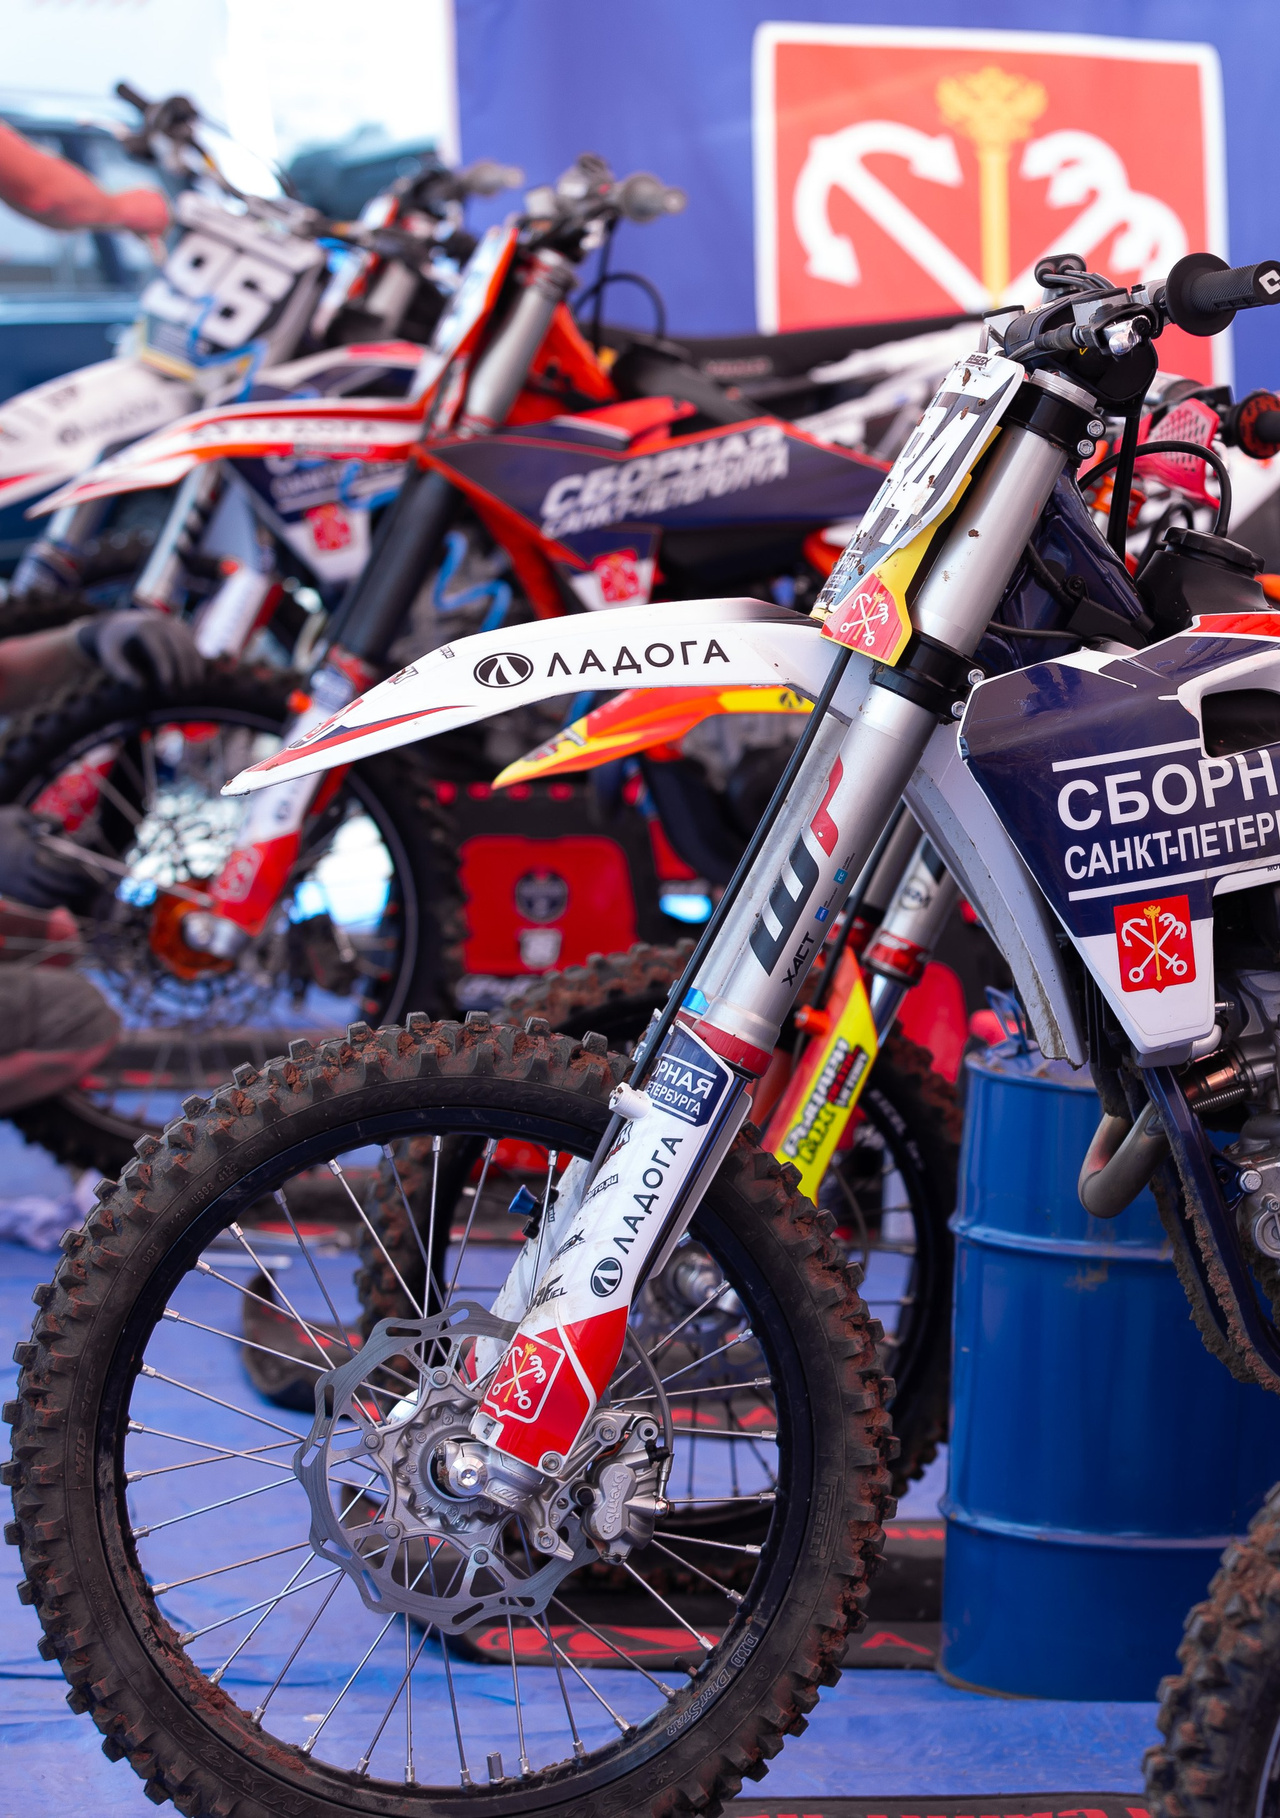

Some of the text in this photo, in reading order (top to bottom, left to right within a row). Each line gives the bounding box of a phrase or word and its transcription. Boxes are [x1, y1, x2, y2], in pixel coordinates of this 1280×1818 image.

[547, 639, 731, 677] ЛАДОГА
[780, 930, 817, 988] XACT
[647, 1080, 702, 1116] ЕТЕРБУРГА
[651, 1059, 715, 1100] РНАЯ
[612, 1136, 684, 1255] ЛАДОГА
[141, 1241, 159, 1264] DOT
[74, 1426, 88, 1479] MID
[602, 1471, 629, 1534] brembo
[808, 1475, 839, 1559] PIRELLI
[730, 1632, 760, 1668] DID
